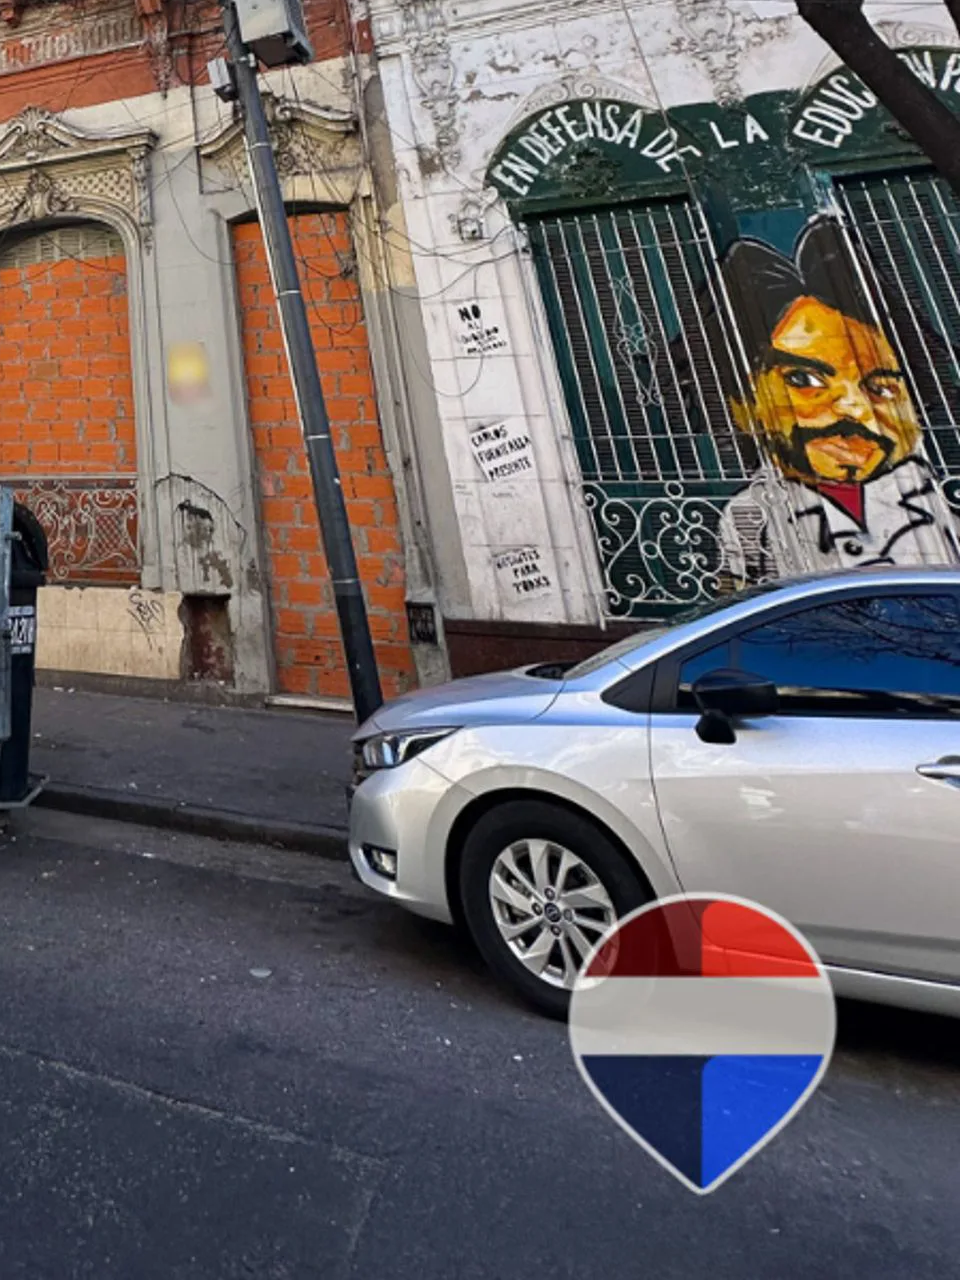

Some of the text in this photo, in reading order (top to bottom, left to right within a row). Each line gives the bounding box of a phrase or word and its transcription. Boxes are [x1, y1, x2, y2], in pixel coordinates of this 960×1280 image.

[492, 153, 538, 195] EN
[519, 102, 642, 165] DEFENSA
[641, 127, 702, 172] DE
[710, 115, 769, 149] LA
[459, 304, 481, 322] NO
[471, 425, 508, 447] CARLOS
[488, 457, 531, 481] PRESENTE
